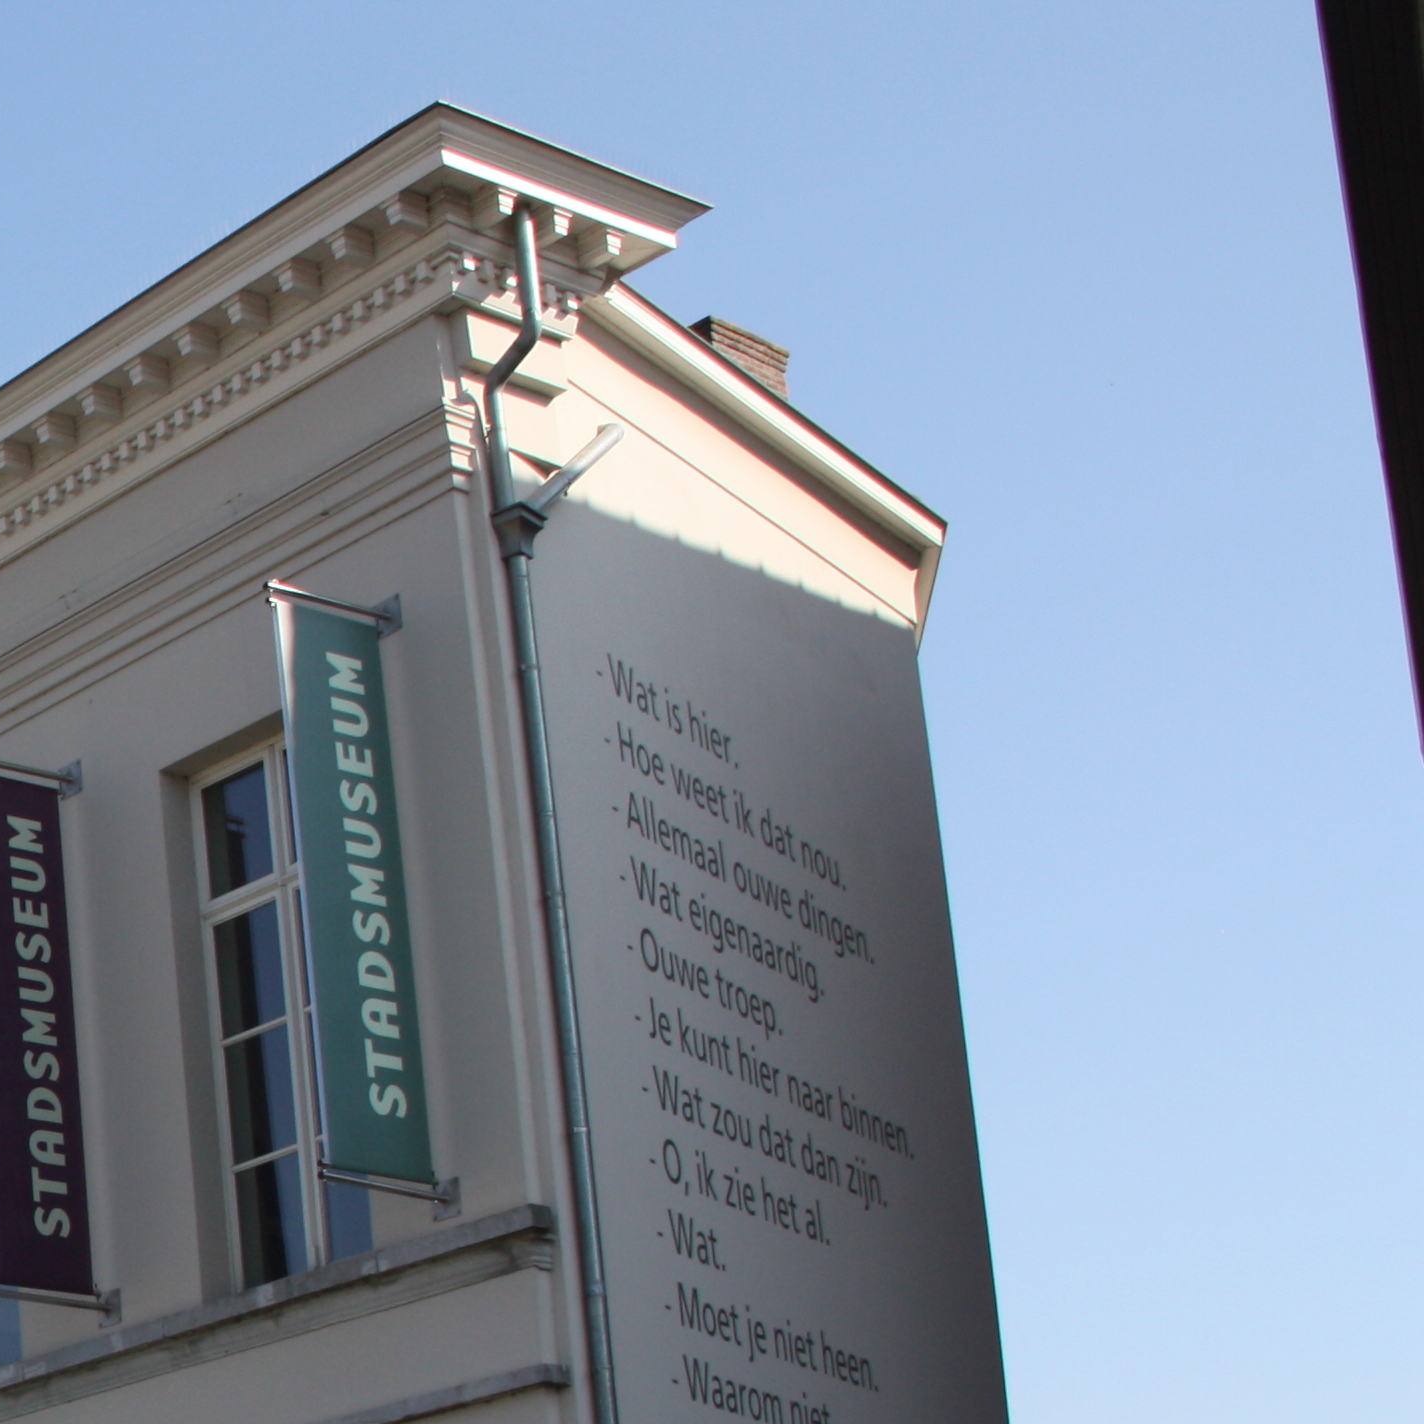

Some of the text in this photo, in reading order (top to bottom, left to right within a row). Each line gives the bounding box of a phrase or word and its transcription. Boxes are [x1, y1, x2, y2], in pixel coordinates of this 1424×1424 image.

[607, 653, 659, 722] Wat
[664, 688, 682, 733] is
[688, 701, 740, 769] hier.
[617, 722, 665, 786] Hoe
[670, 760, 728, 824] weet
[734, 789, 756, 838] ik
[760, 808, 796, 862] dat
[801, 841, 847, 891] nou.
[626, 791, 726, 882] Allemaal
[734, 860, 791, 919] ouwe
[799, 890, 875, 965] dingen.
[325, 651, 408, 1119] STADSMUSEUM
[631, 856, 683, 921] Wat
[689, 895, 824, 1002] eigenaardig.
[6, 814, 71, 1239] STADSMUSEUM
[640, 927, 709, 995] Ouwe
[715, 969, 783, 1041] troep.
[649, 997, 672, 1046] Je
[678, 1009, 733, 1075] kunt
[738, 1044, 780, 1095] hier
[787, 1075, 833, 1121] naar
[839, 1087, 914, 1160] binnen.
[652, 1065, 705, 1128] Wat
[711, 1103, 752, 1149] zou
[760, 1114, 797, 1169] dat
[801, 1133, 841, 1188] dan
[846, 1157, 887, 1211] zijn.
[663, 1138, 690, 1196] O,
[695, 1150, 718, 1201] ik
[723, 1168, 756, 1217] zie
[762, 1177, 799, 1234] het
[805, 1200, 830, 1246] al.
[668, 1209, 726, 1271] Wat.
[677, 1282, 740, 1346] Moet
[745, 1307, 767, 1363] je
[774, 1319, 816, 1372] niet
[821, 1330, 879, 1392] heen.
